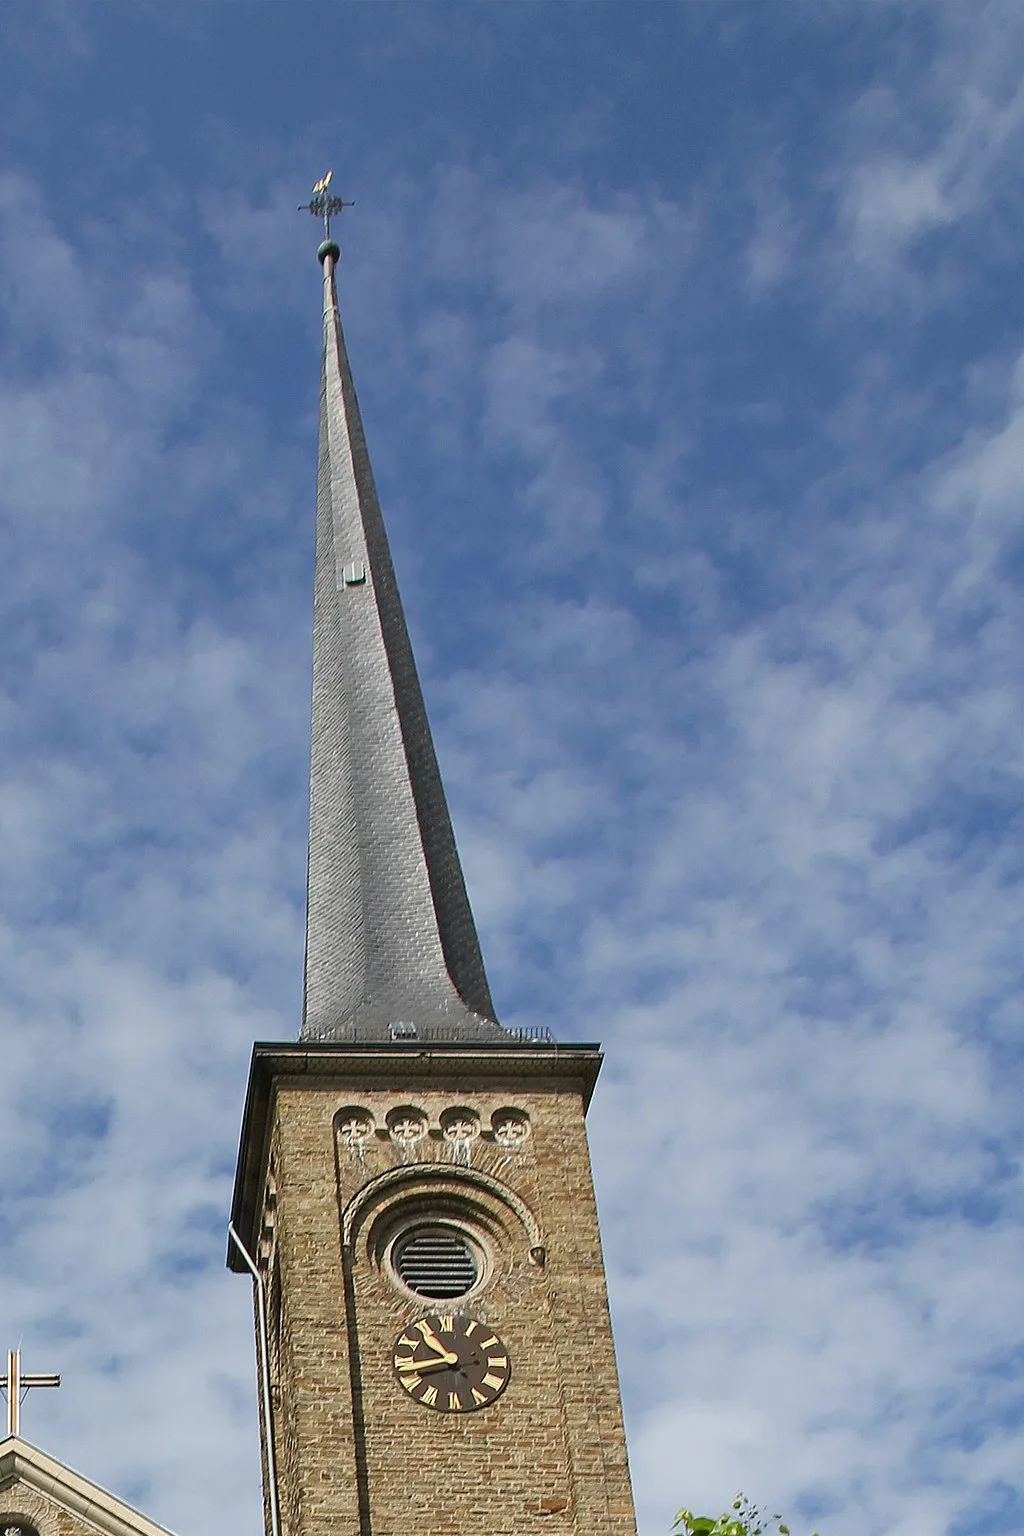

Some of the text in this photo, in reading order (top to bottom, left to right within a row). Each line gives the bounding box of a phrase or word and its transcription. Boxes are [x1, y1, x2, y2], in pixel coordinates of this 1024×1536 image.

[438, 1315, 454, 1333] XII
[464, 1320, 479, 1337] I
[398, 1334, 420, 1352] X
[480, 1335, 499, 1350] II
[487, 1355, 507, 1369] III
[419, 1385, 439, 1407] VII
[447, 1391, 462, 1410] VI
[470, 1387, 488, 1406] V
